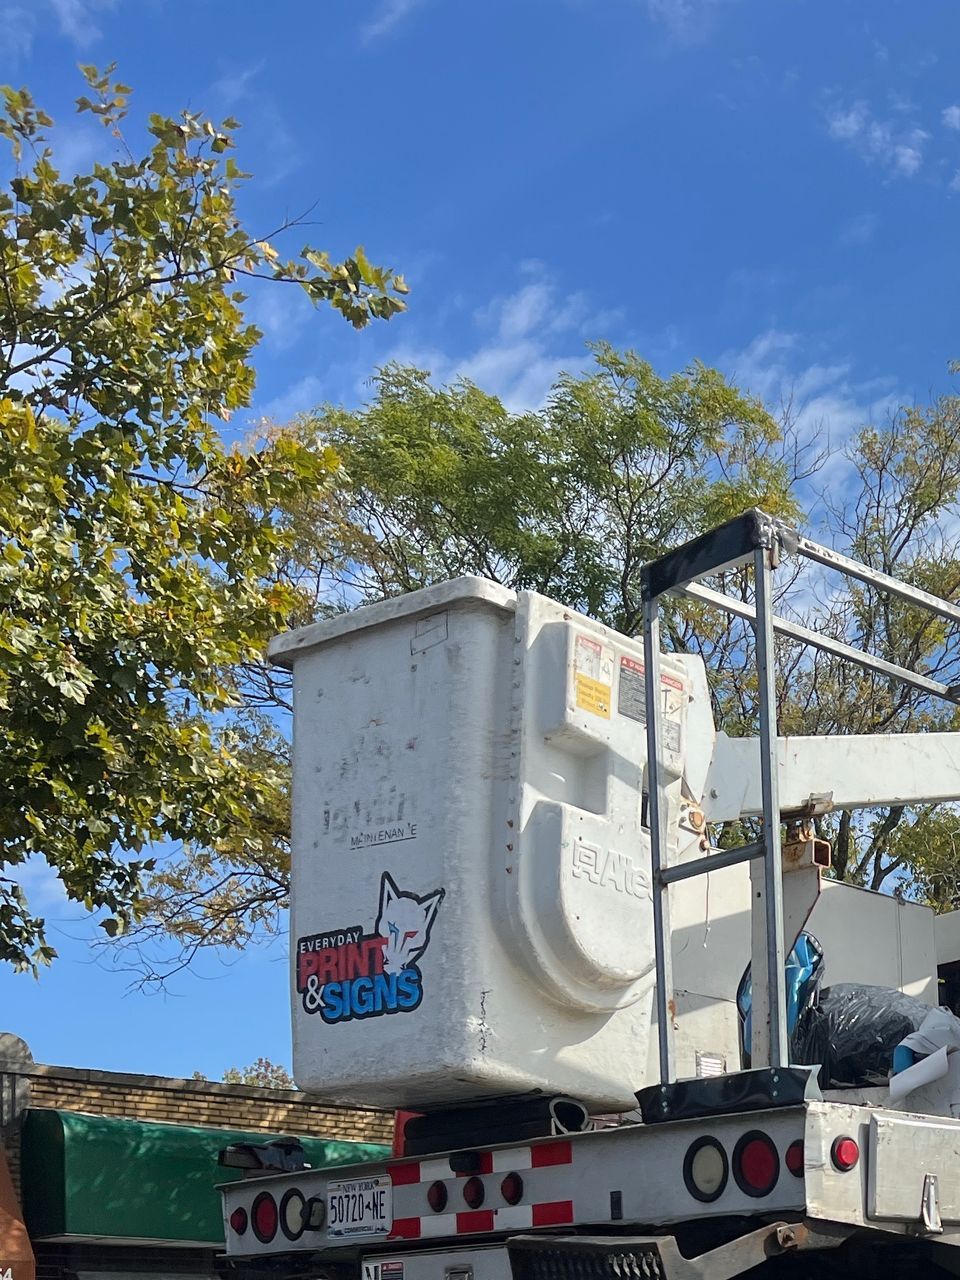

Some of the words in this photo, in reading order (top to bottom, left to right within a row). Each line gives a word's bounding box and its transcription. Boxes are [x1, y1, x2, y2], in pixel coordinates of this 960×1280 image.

[300, 931, 361, 953] EVERYDAY
[300, 936, 389, 988] PRINT
[305, 974, 325, 1010] &
[322, 968, 419, 1019] SIGNS
[342, 1184, 356, 1193] NEW
